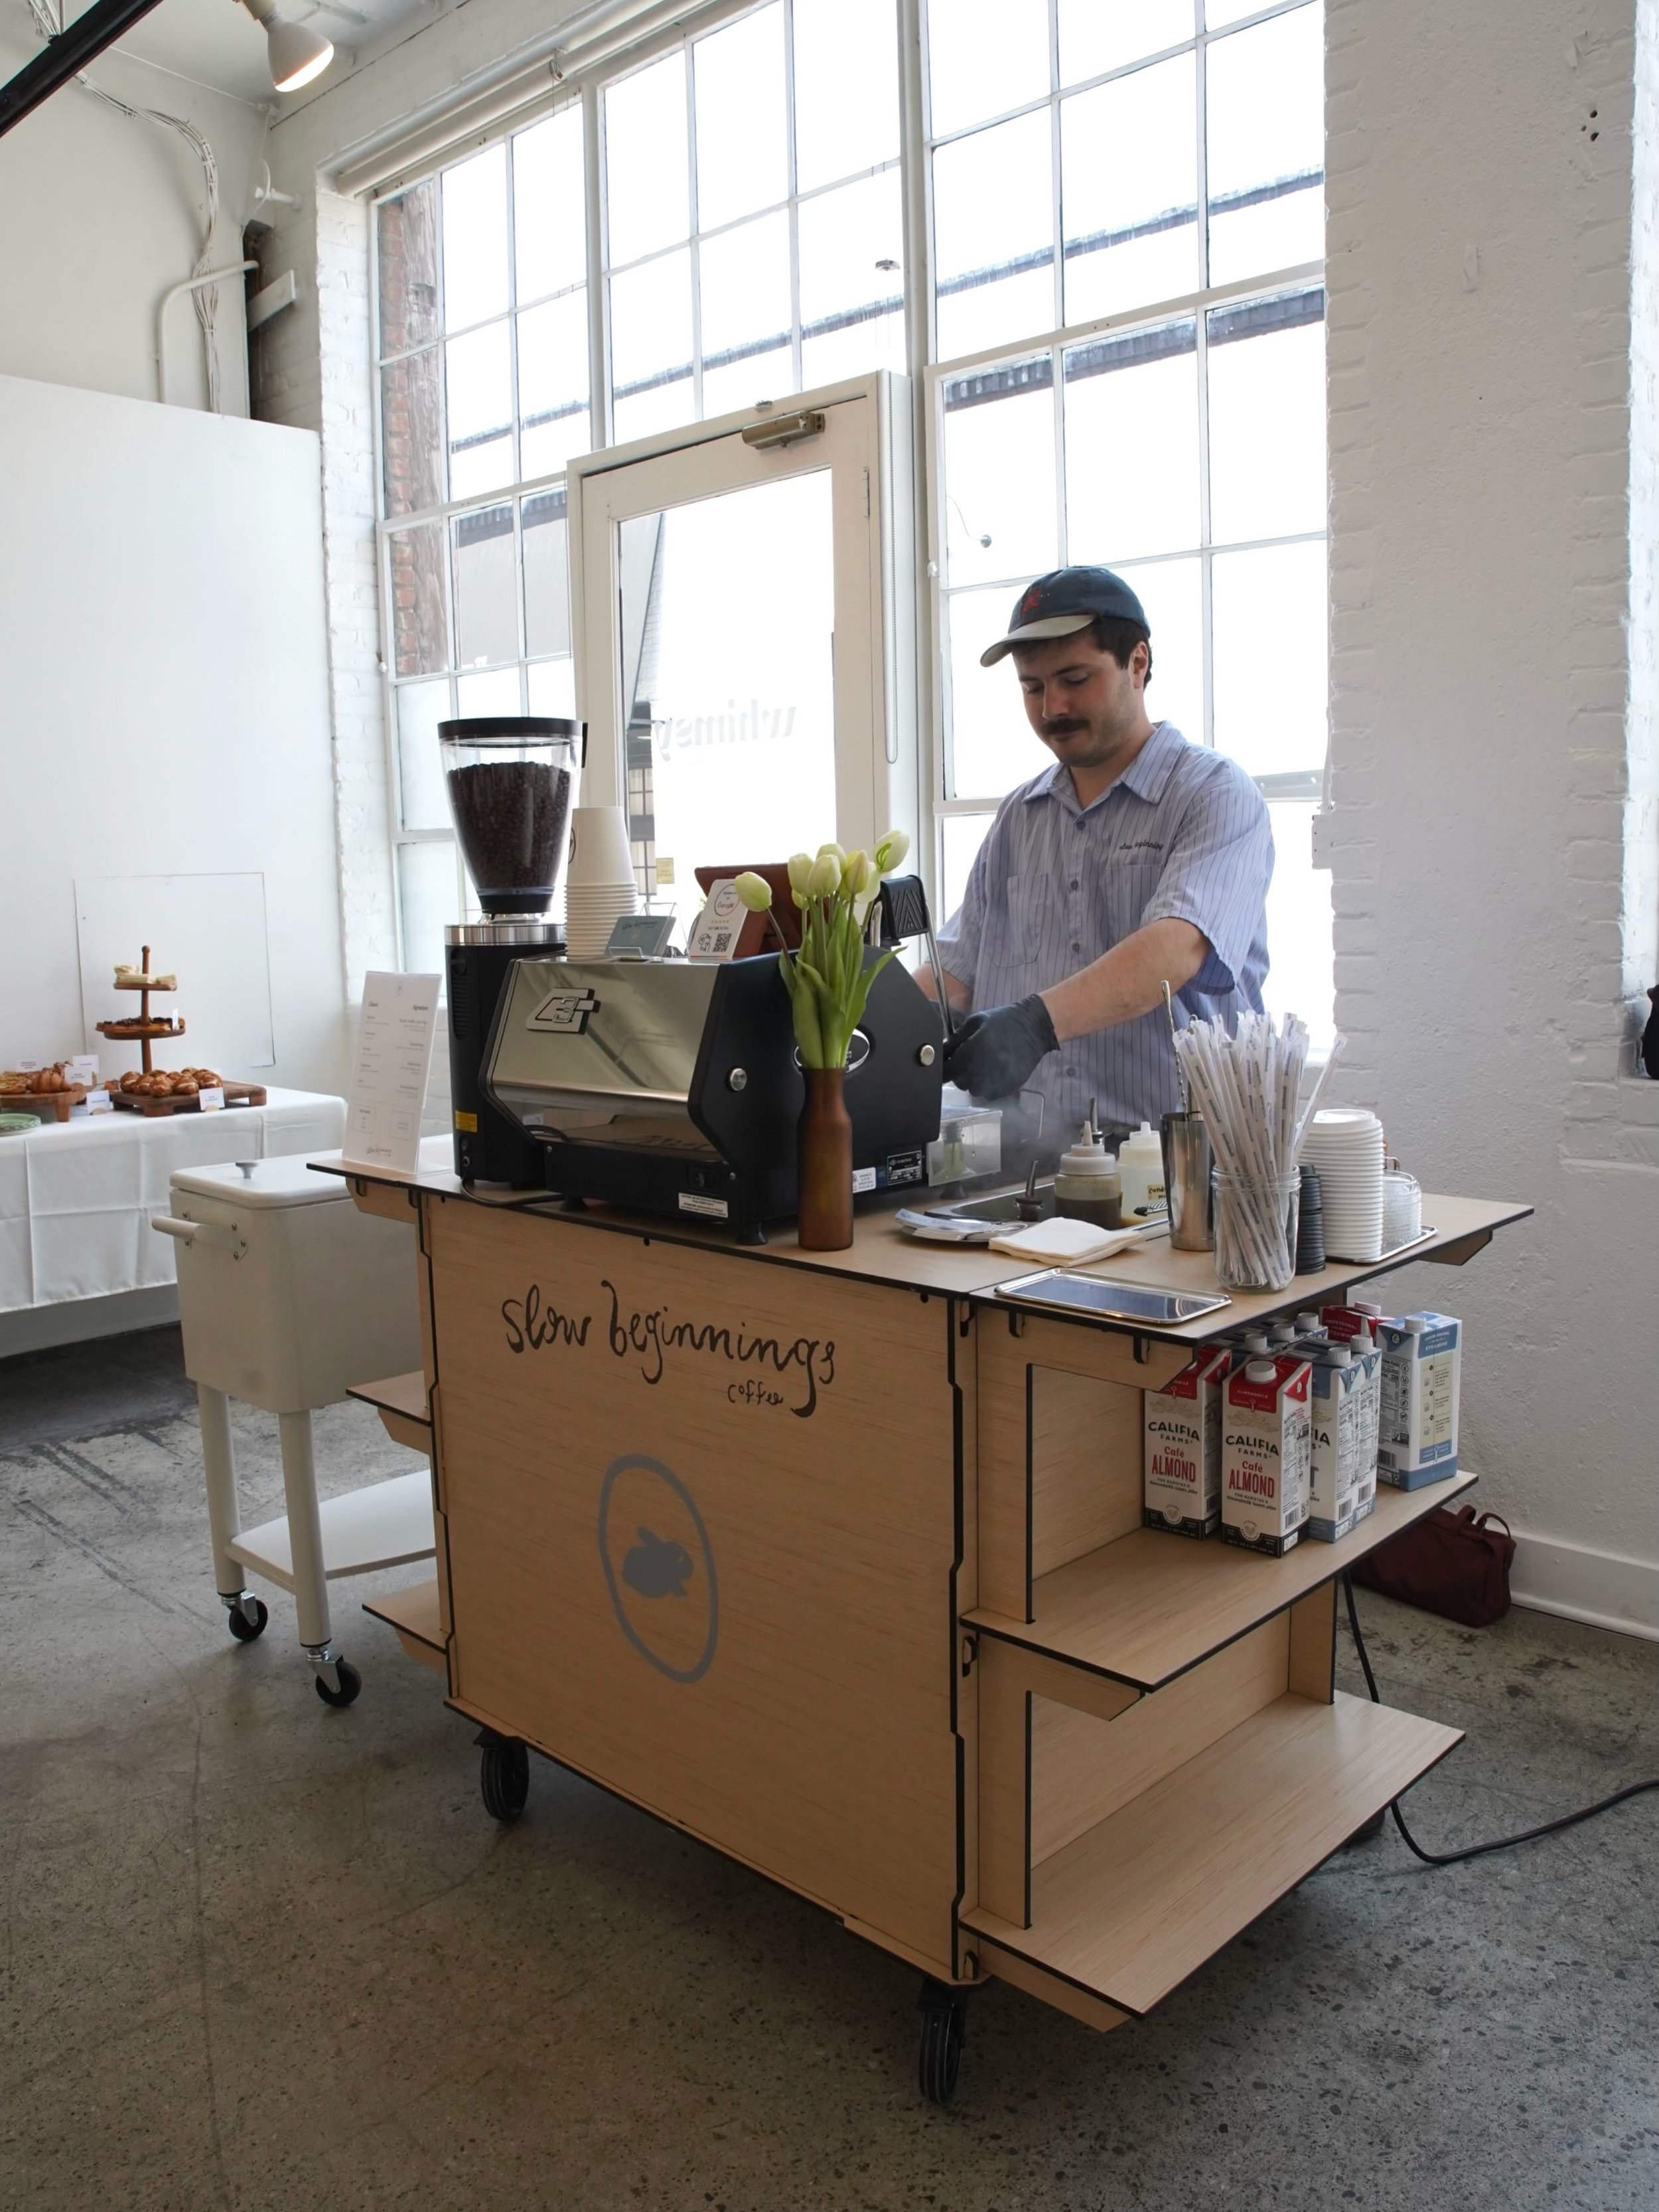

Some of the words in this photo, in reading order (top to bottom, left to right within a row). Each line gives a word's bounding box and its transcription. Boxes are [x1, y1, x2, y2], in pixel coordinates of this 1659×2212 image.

[601, 1280, 835, 1418] beginnings
[728, 1380, 784, 1406] coffee
[1148, 1422, 1200, 1441] CALIFIA
[1164, 1445, 1185, 1458] Café
[1226, 1435, 1279, 1456] CALIFIA
[1151, 1454, 1196, 1483] ALMOND
[1242, 1460, 1263, 1473] Café
[1228, 1469, 1275, 1499] ALMOND
